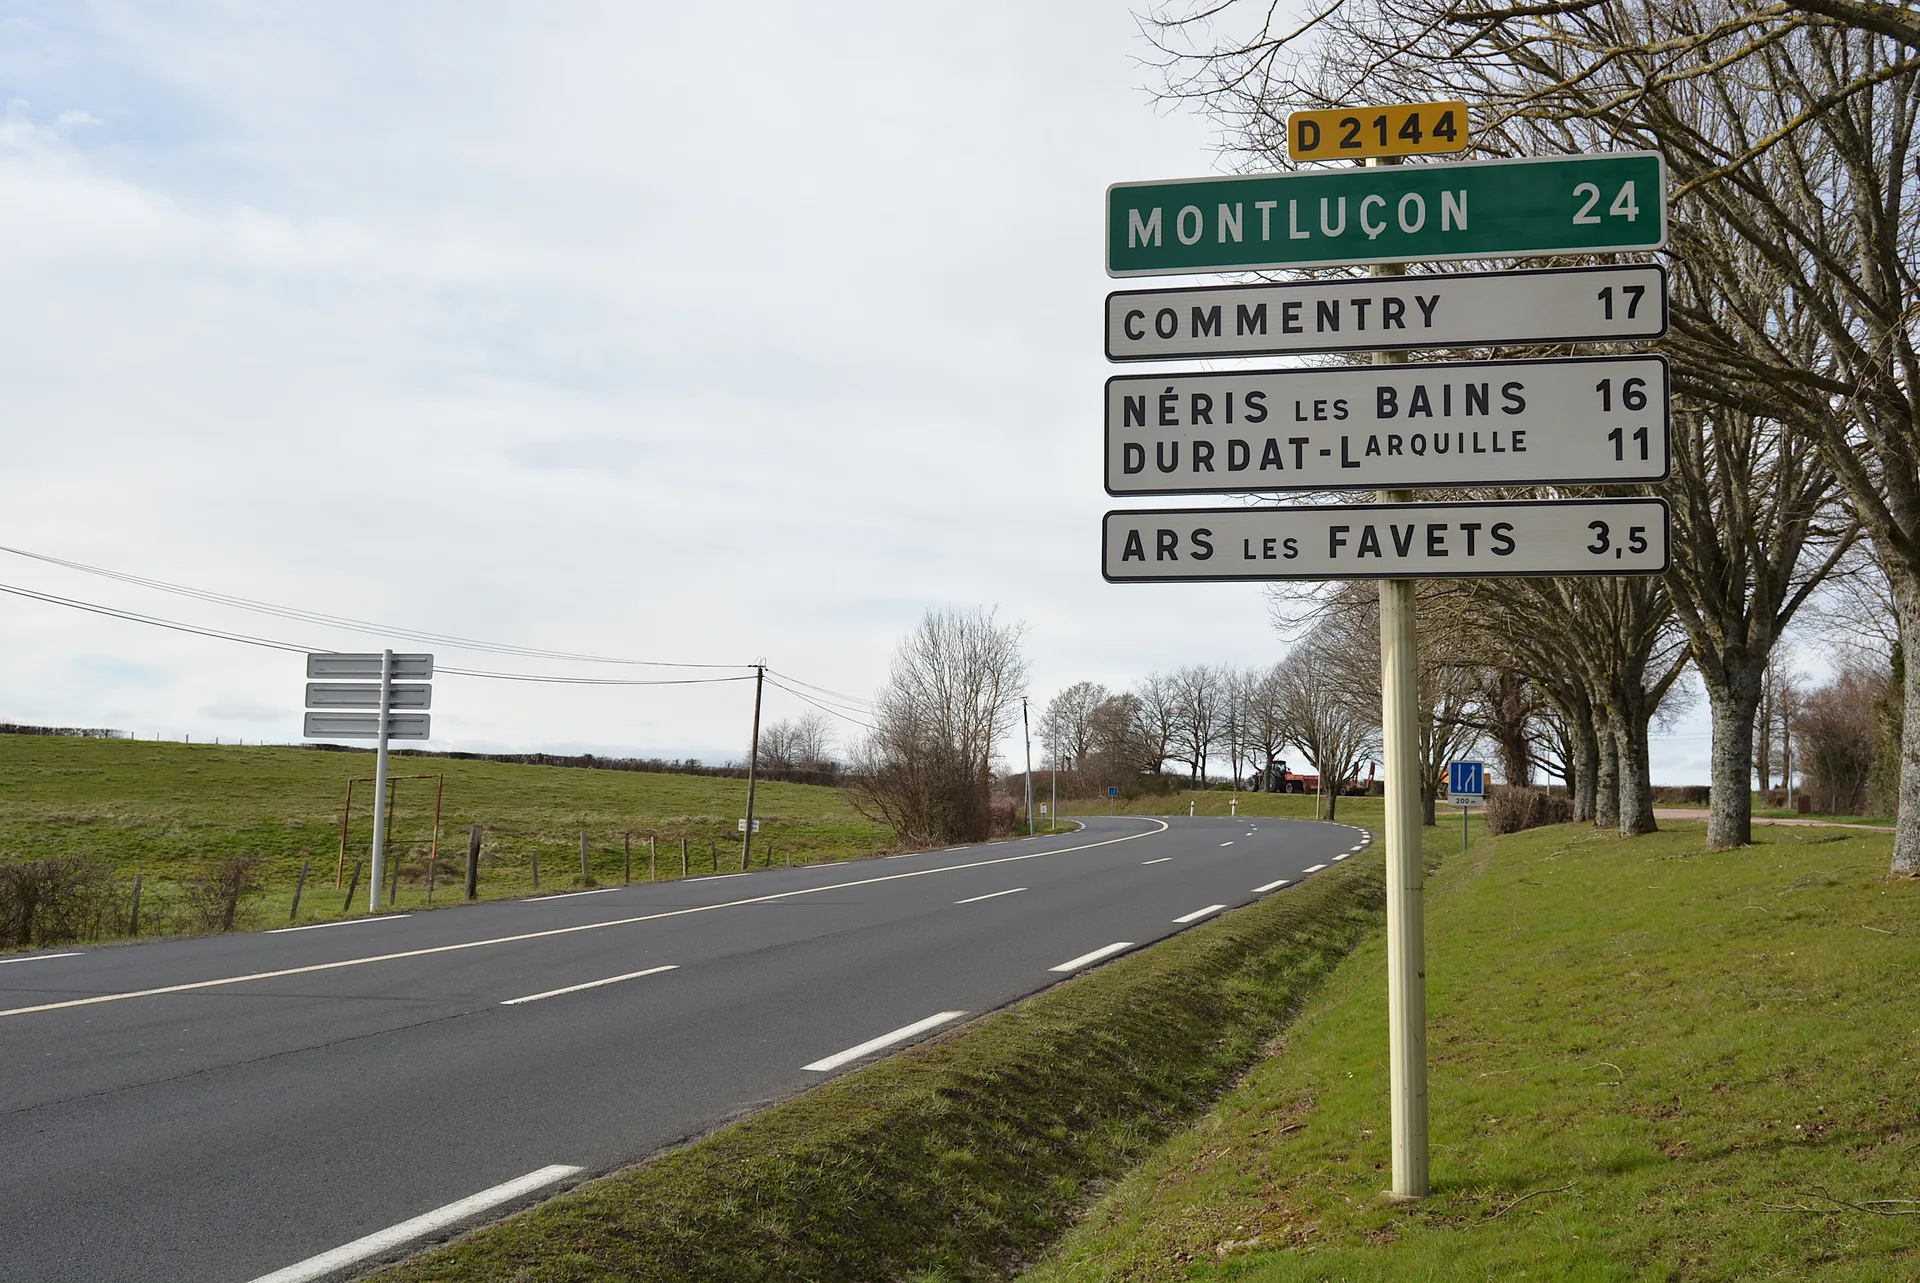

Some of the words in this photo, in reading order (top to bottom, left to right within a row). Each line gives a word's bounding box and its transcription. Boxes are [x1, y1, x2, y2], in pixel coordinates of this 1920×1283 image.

[1298, 120, 1320, 152] D
[1339, 110, 1457, 149] 2144
[1127, 190, 1469, 248] MONTLUÇON
[1572, 181, 1639, 224] 24
[1124, 295, 1441, 341] COMMENTRY
[1597, 285, 1646, 320] 17
[1124, 386, 1268, 427] NÉRIS
[1295, 400, 1349, 422] LES
[1377, 381, 1527, 419] BAINS
[1596, 377, 1648, 412] 16
[1124, 430, 1527, 474] DURDAT-LARQUILLE
[1608, 427, 1649, 461] 11
[1122, 528, 1214, 562] ARS
[1243, 538, 1299, 560] LES
[1329, 522, 1516, 558] FAVETS
[1587, 520, 1648, 559] 3,5
